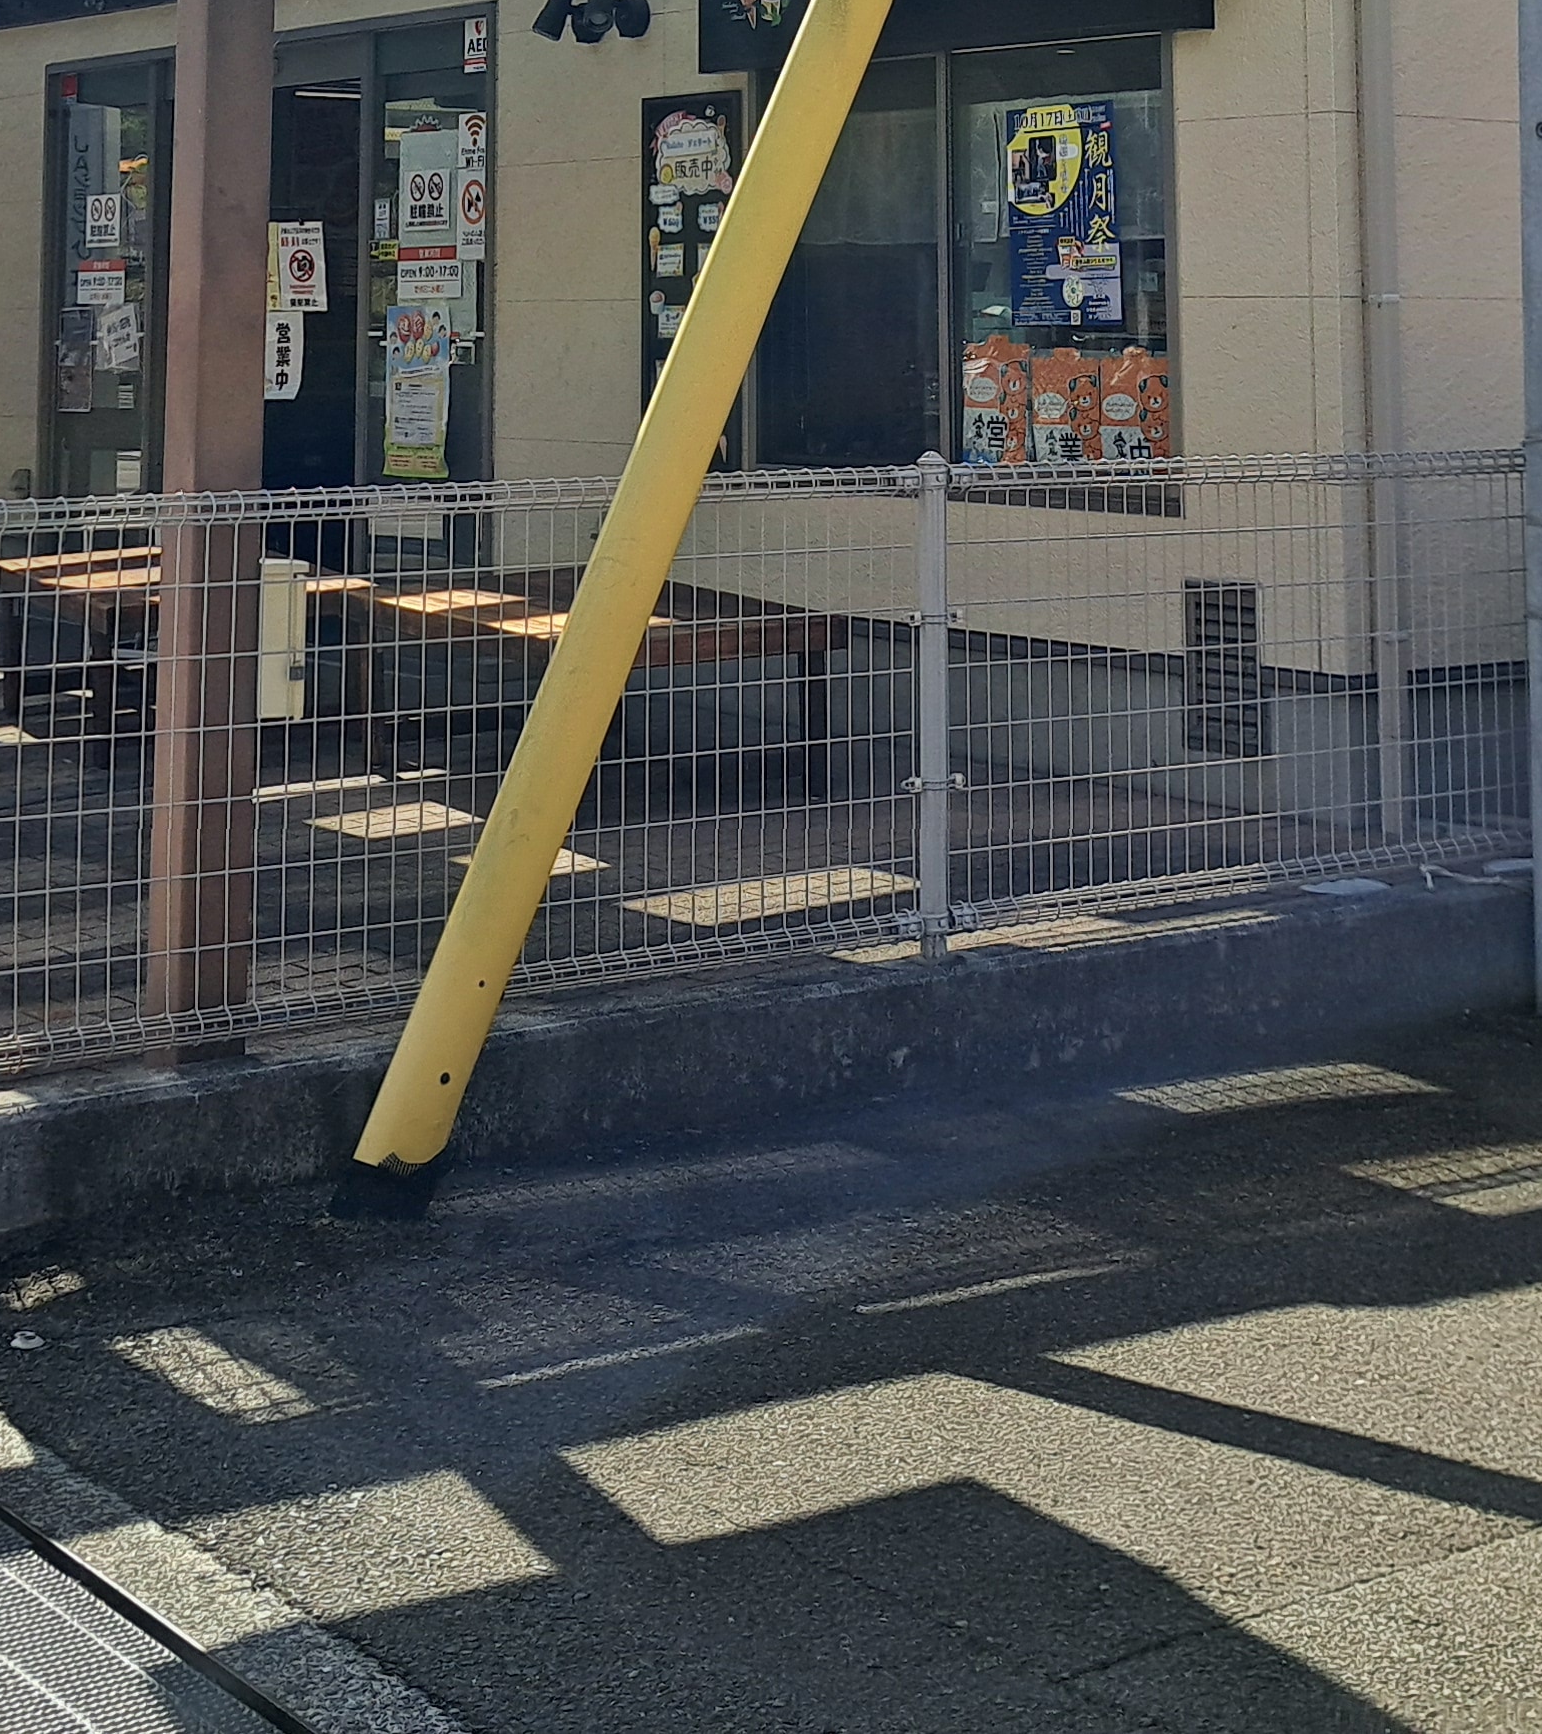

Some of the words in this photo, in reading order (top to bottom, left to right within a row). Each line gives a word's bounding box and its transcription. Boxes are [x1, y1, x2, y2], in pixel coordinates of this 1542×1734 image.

[675, 155, 713, 180] 販売中
[1084, 129, 1115, 253] 観月祭
[275, 322, 292, 391] 営業中
